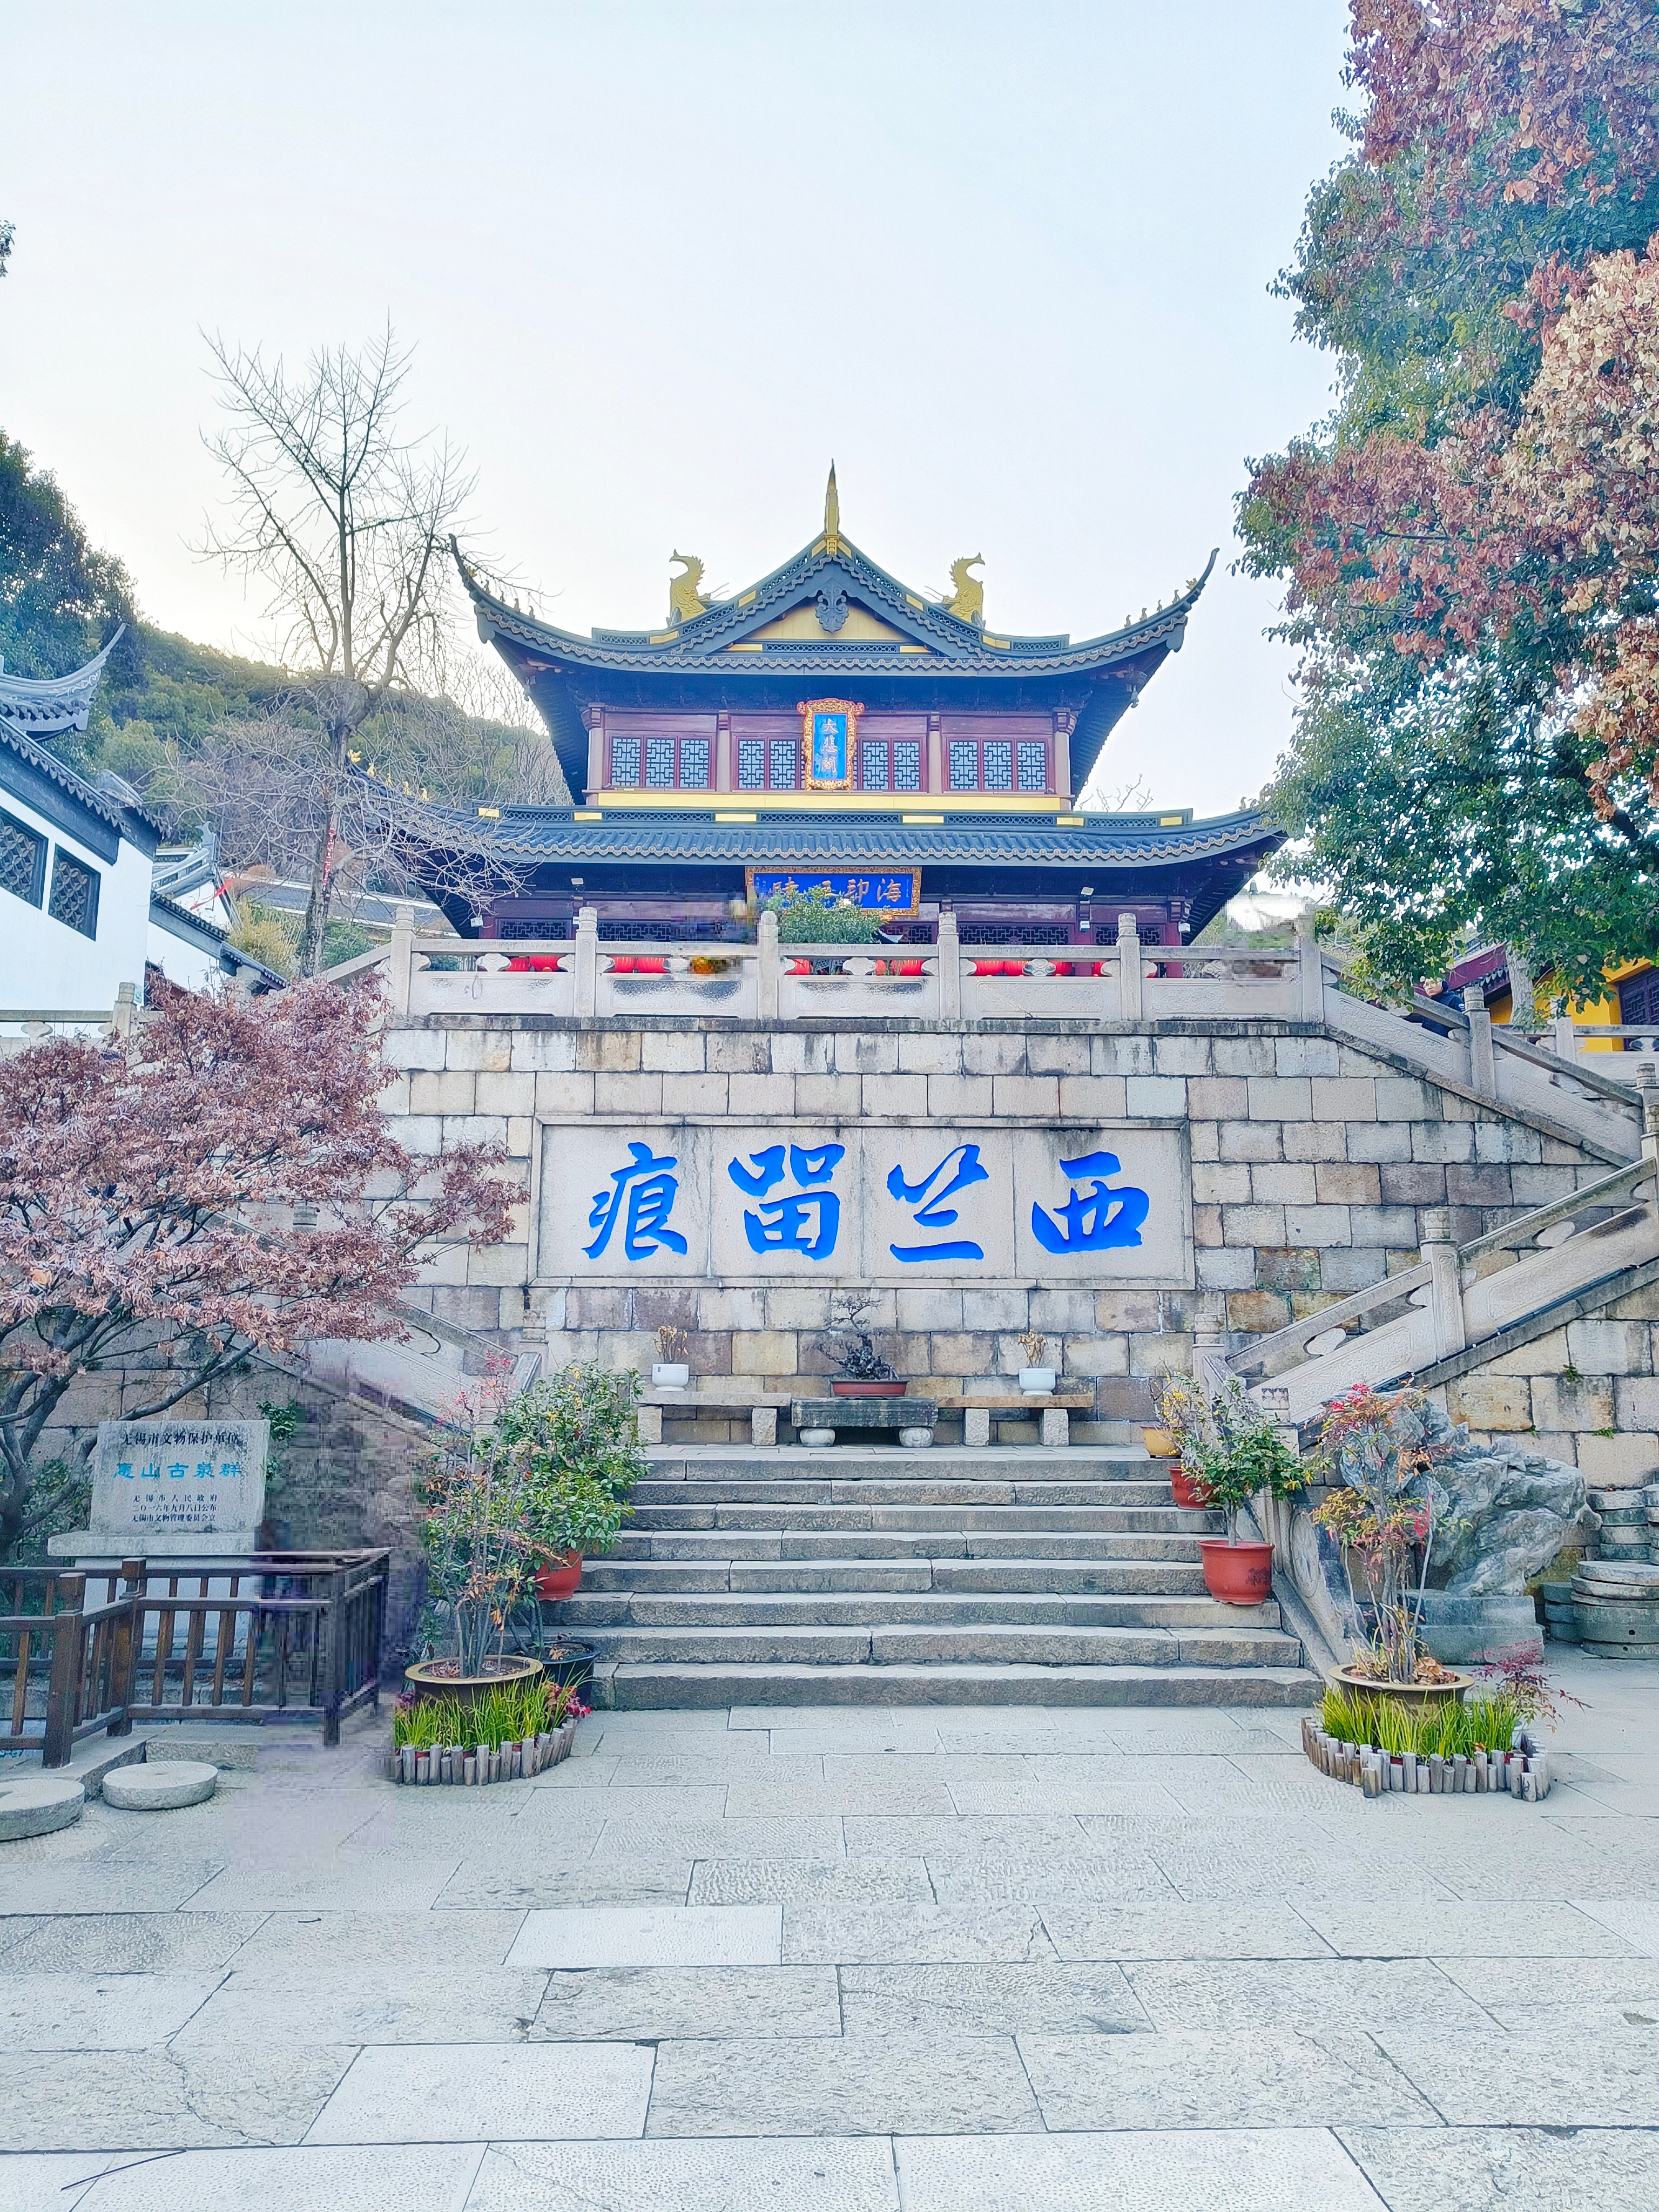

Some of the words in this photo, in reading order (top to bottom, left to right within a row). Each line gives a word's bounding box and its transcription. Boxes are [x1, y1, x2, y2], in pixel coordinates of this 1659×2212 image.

[121, 1433, 238, 1445] 无锡市文物保护单位
[113, 1461, 242, 1480] 惠山古泉群
[133, 1494, 217, 1502] 无锡市人民政府
